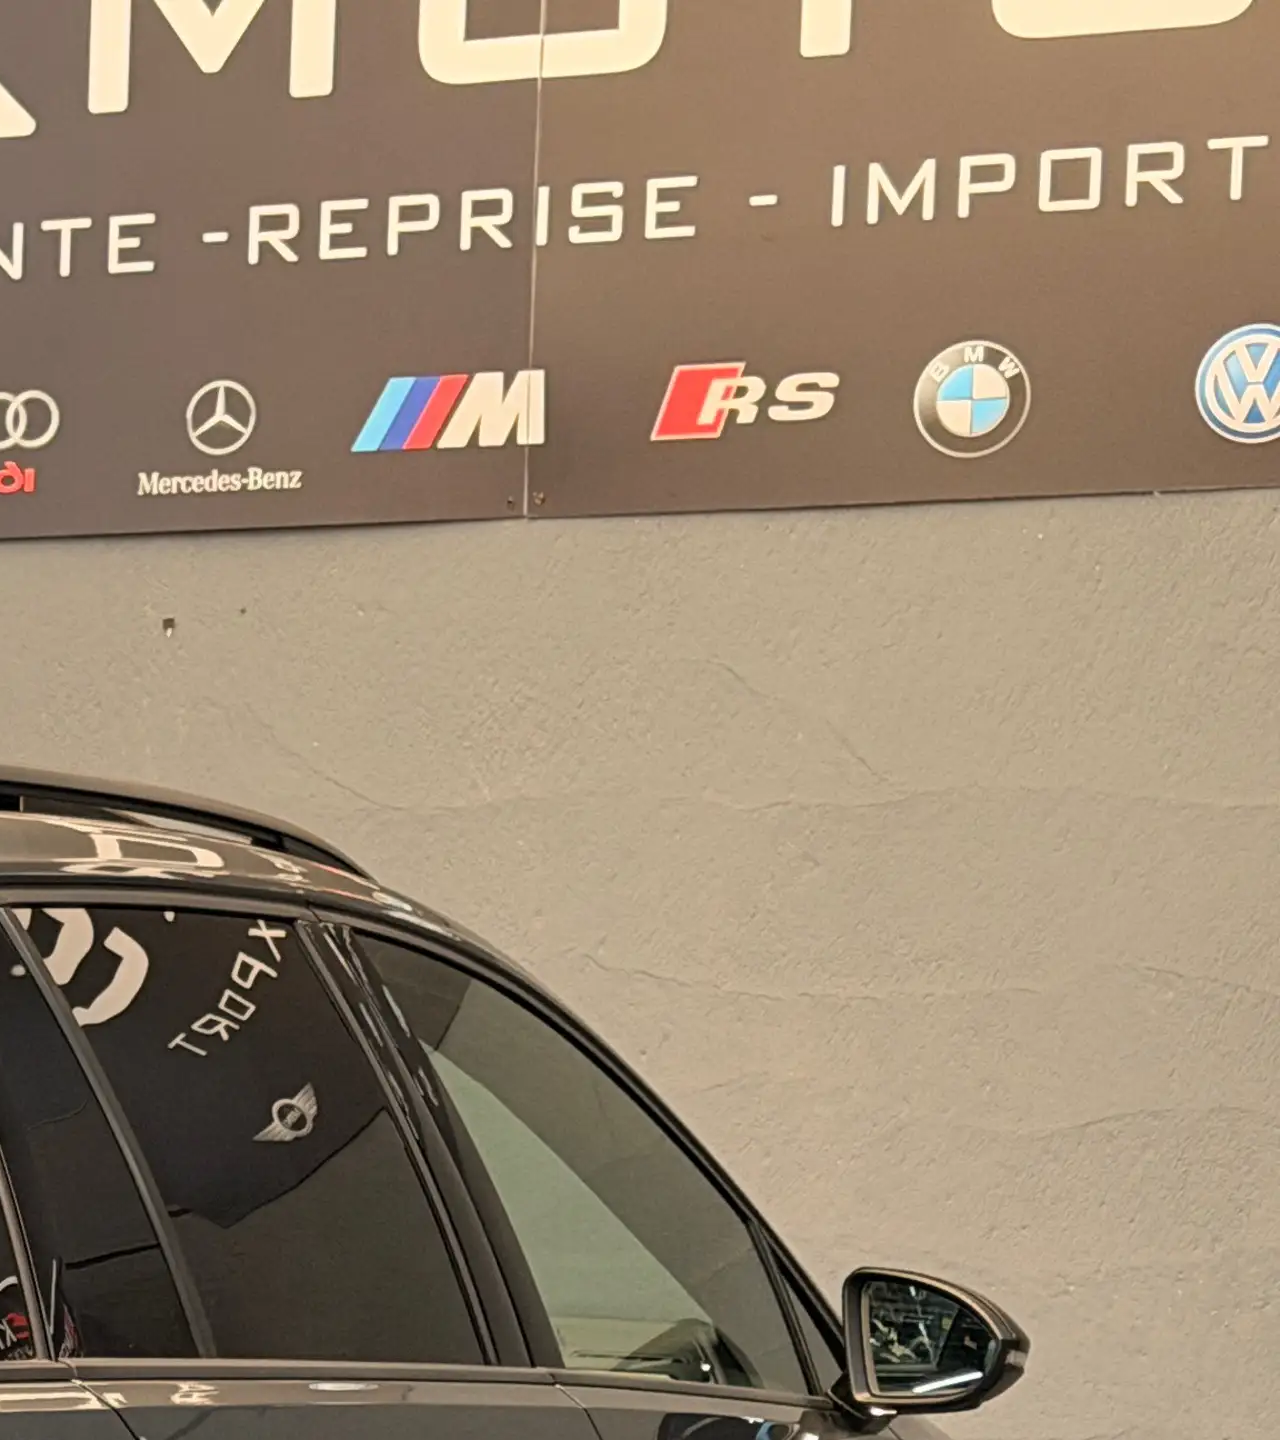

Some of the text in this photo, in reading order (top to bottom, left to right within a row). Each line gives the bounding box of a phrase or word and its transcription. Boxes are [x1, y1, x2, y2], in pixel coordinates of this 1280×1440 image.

[831, 135, 1269, 227] IMPORT
[696, 371, 840, 426] RS
[137, 468, 302, 497] Mercedes-Benz
